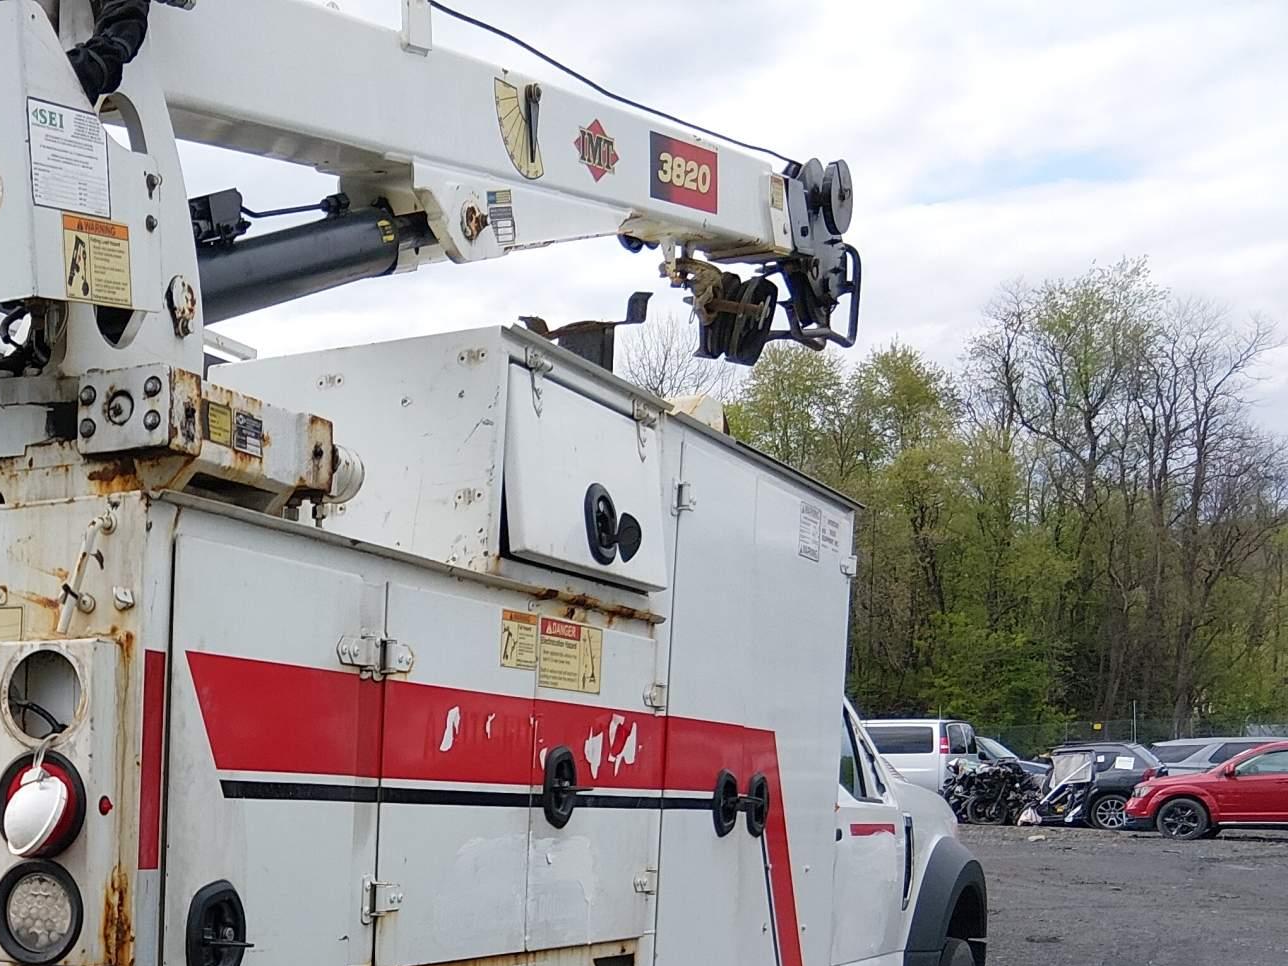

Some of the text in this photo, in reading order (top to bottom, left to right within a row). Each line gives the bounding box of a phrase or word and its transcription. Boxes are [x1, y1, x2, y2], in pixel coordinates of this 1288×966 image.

[39, 108, 64, 129] SEI
[579, 126, 614, 174] IMT
[658, 152, 711, 193] 3820
[84, 221, 116, 236] WARNING
[551, 622, 577, 638] DANGER
